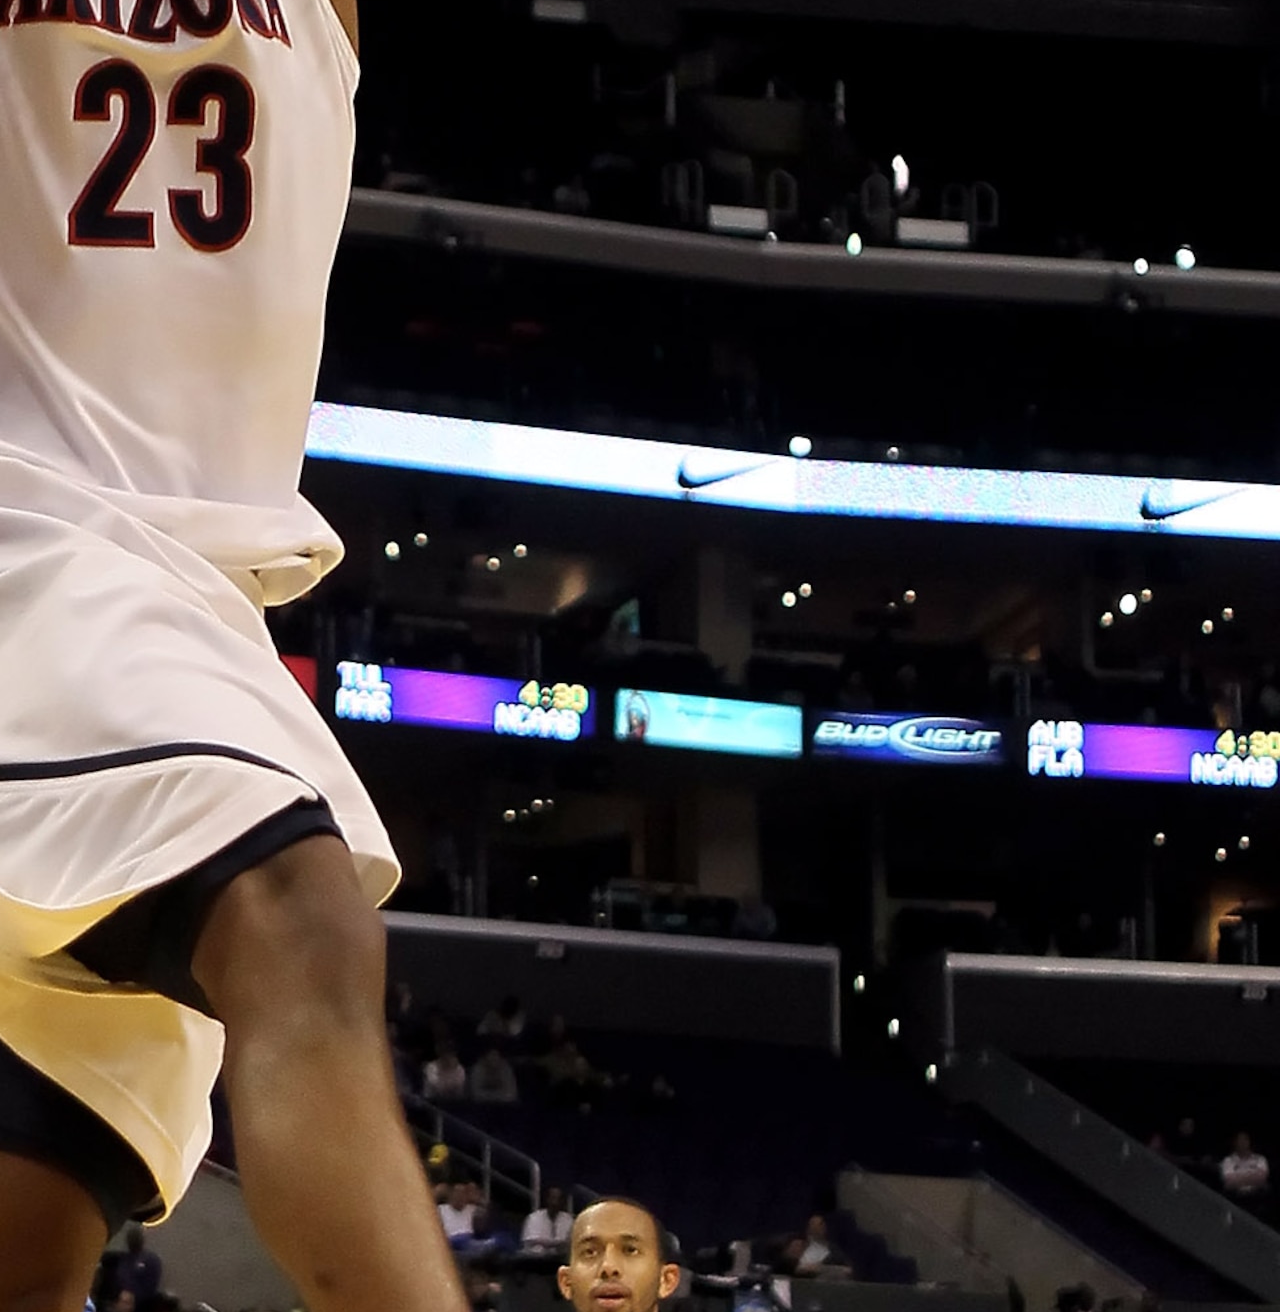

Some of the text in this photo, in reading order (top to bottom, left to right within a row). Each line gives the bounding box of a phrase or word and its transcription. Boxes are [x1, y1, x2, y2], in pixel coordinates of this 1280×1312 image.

[67, 58, 256, 253] 23
[519, 680, 589, 715] 4:30
[814, 720, 1002, 752] BUD LIGHT
[1028, 719, 1084, 749] AUB
[1028, 744, 1084, 777] FLA
[1190, 752, 1279, 788] NCAAB
